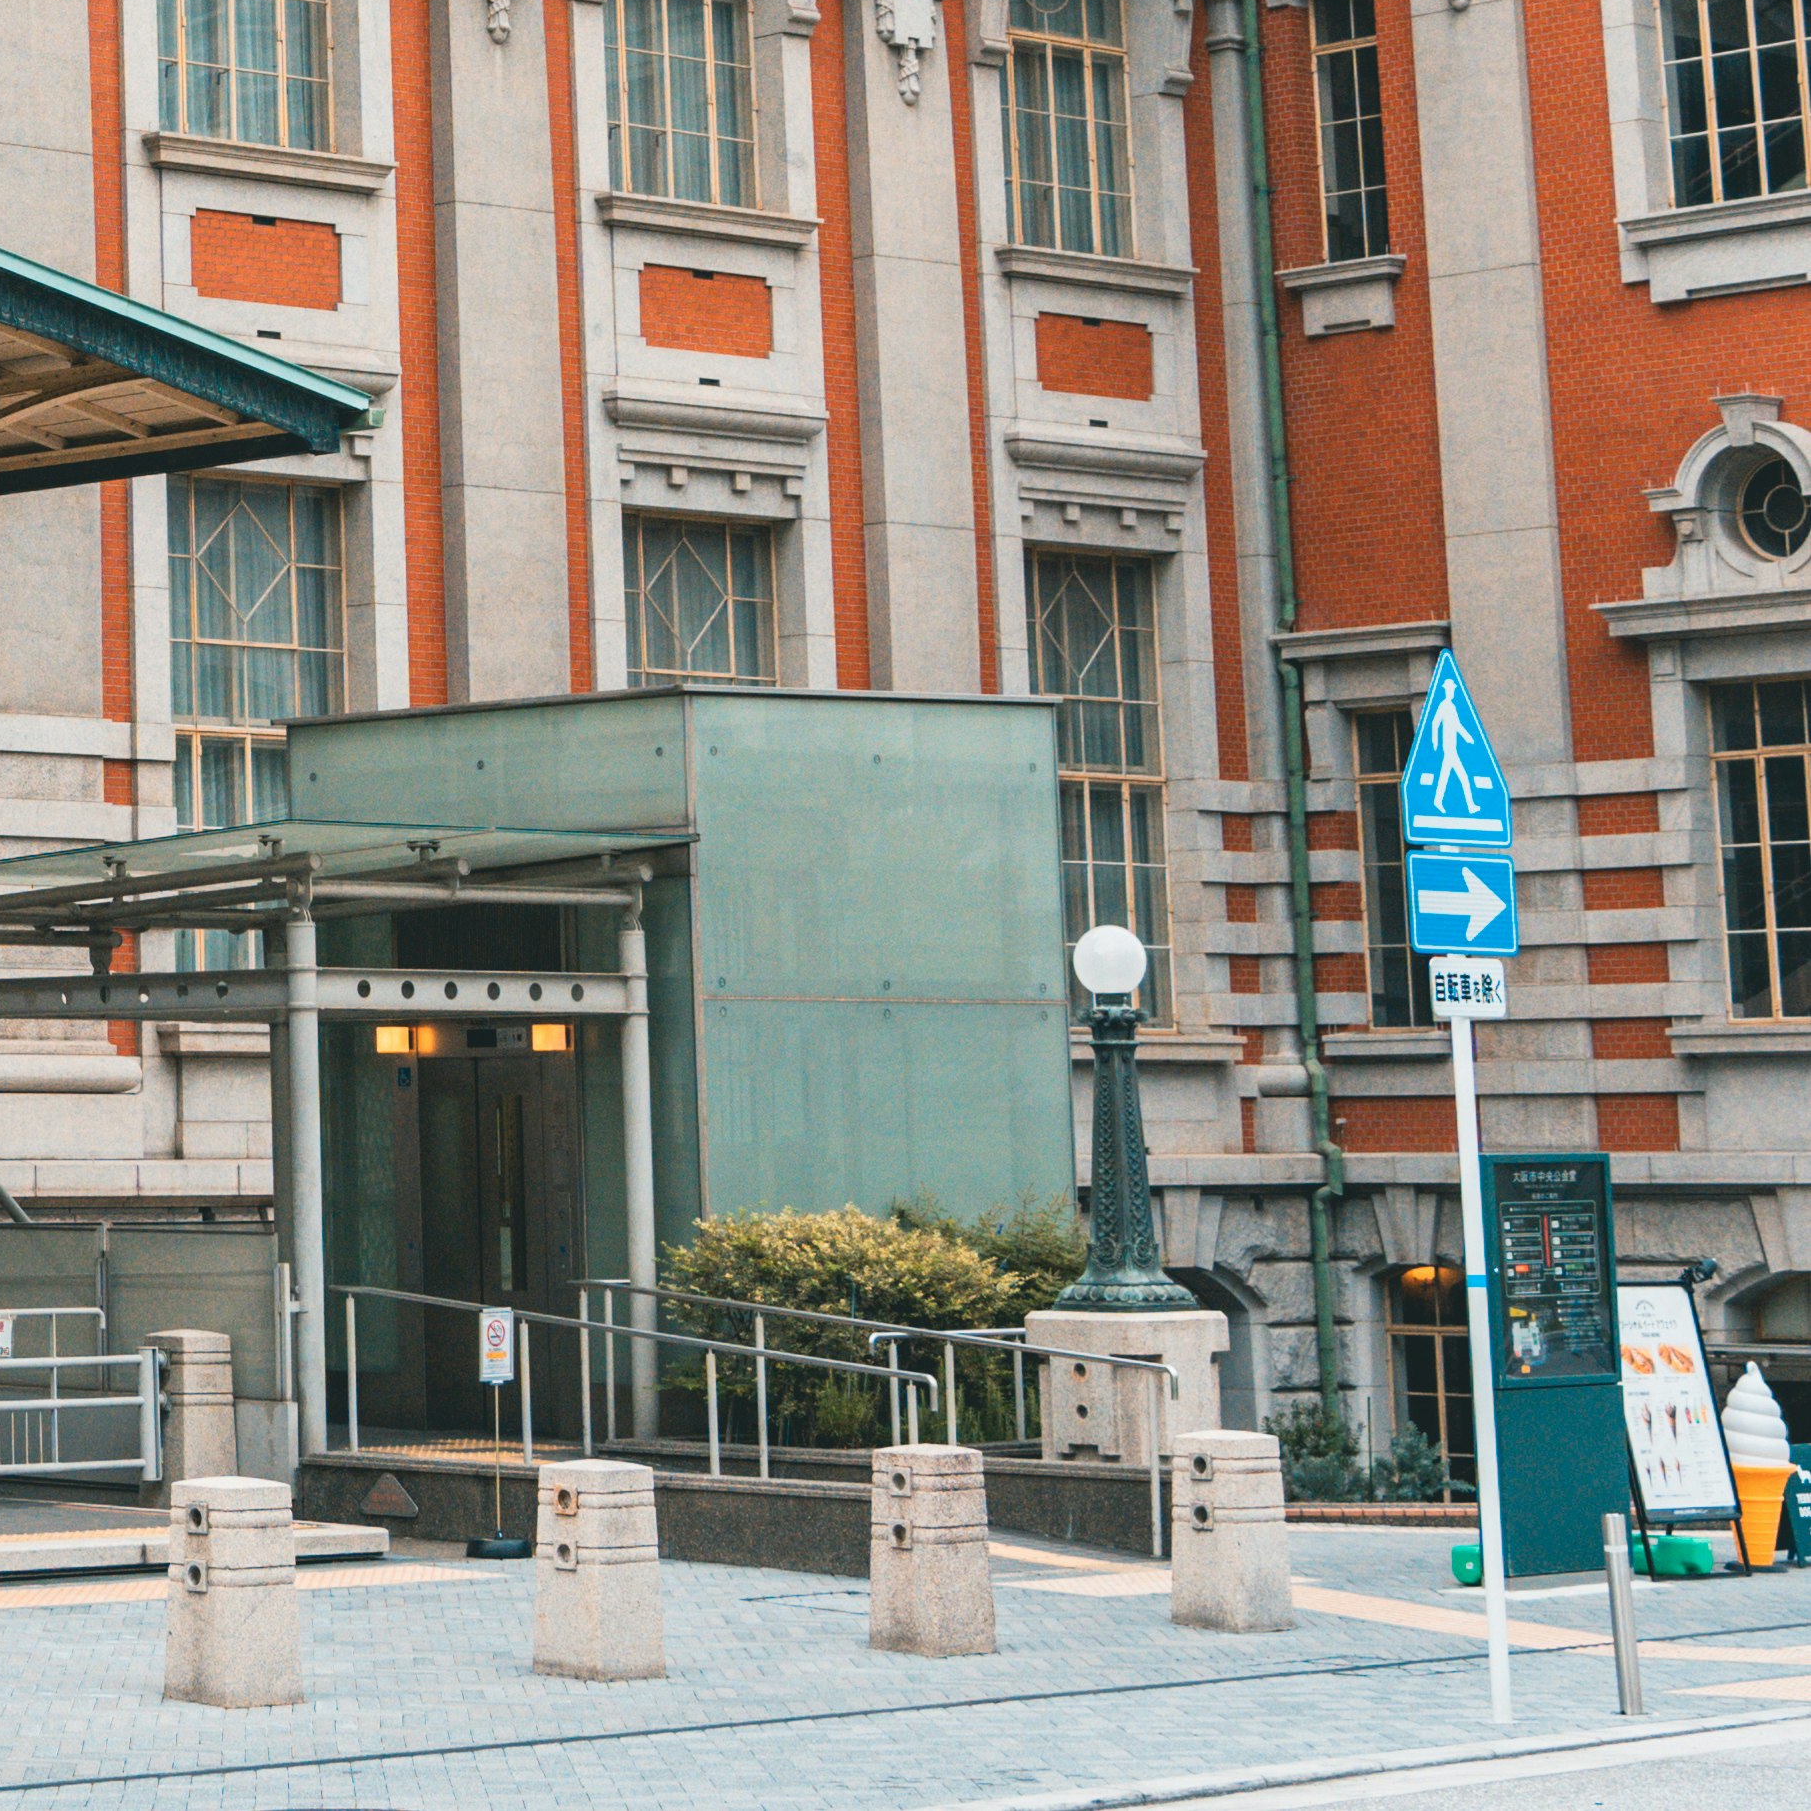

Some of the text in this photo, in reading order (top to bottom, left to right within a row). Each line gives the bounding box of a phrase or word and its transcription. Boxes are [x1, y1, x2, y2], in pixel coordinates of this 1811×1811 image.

[1435, 972, 1502, 1003] 自転車を除く
